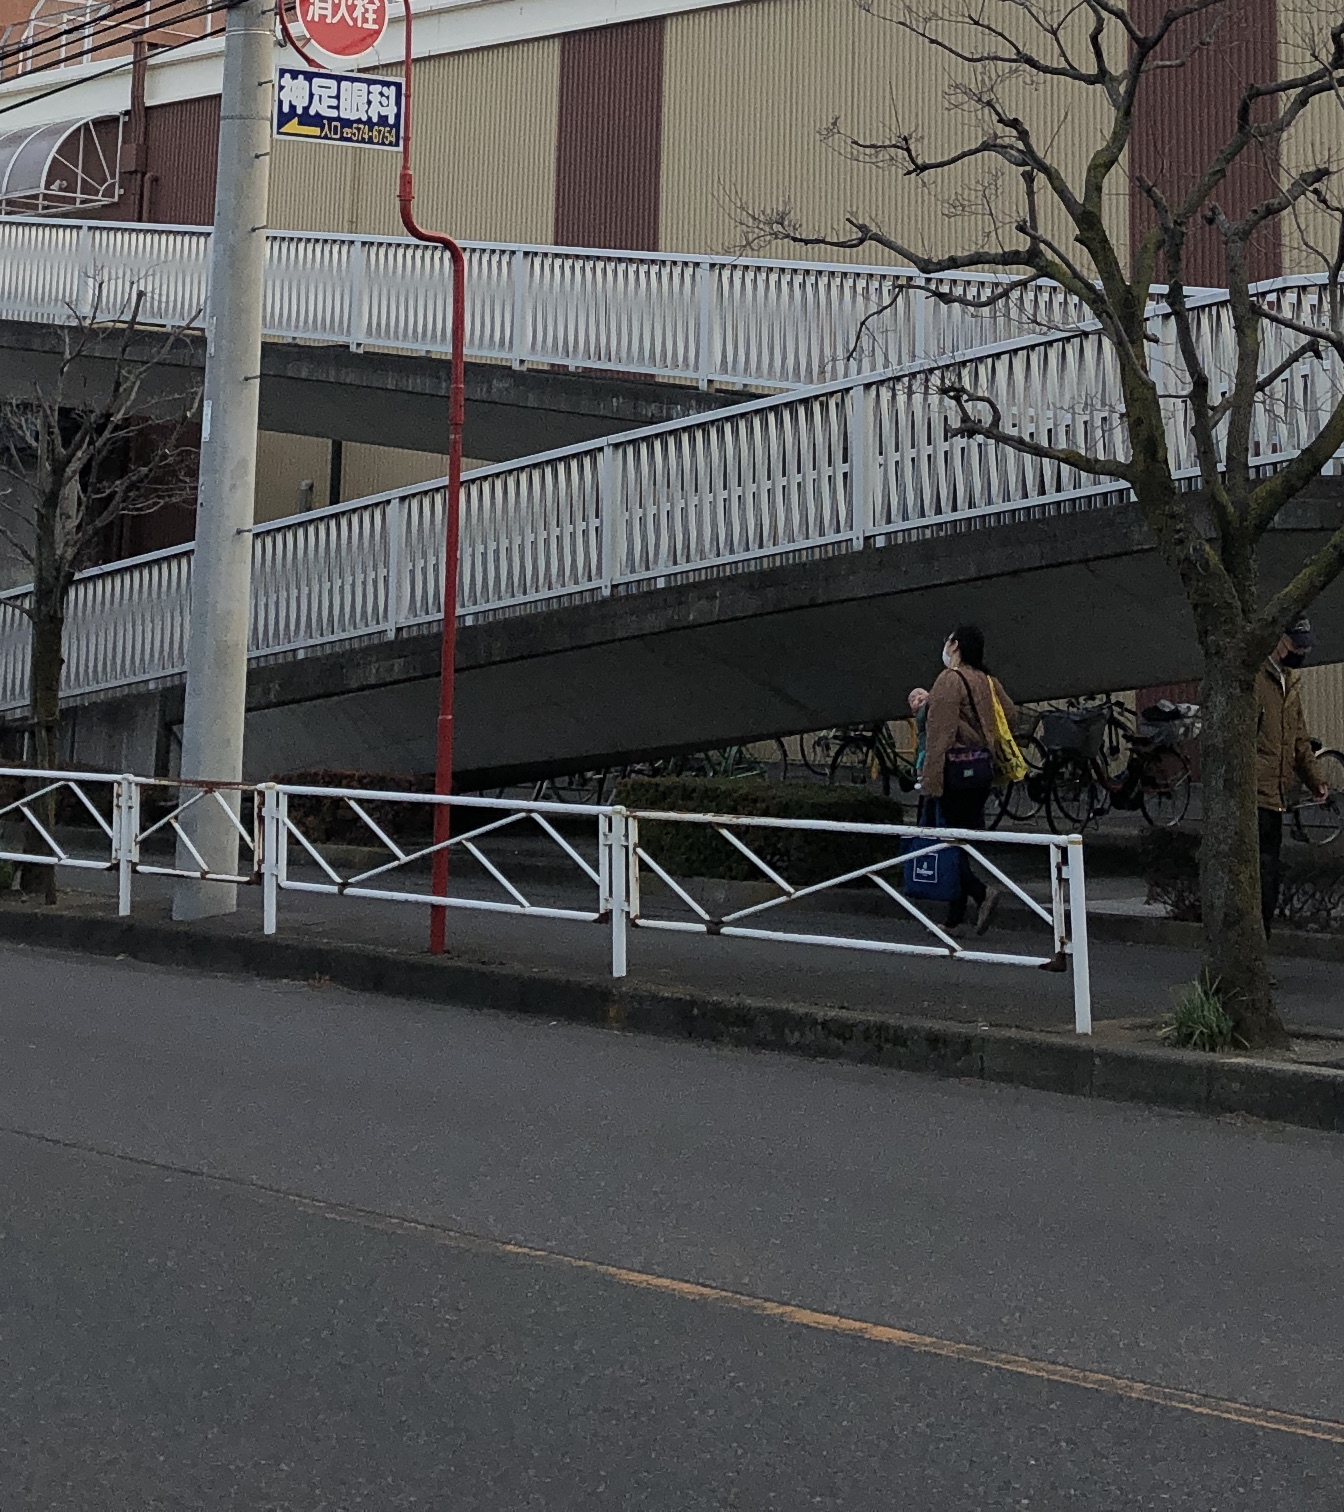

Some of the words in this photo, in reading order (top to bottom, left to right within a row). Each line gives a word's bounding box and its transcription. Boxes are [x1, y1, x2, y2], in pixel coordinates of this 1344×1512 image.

[279, 72, 397, 125] 神足眼科
[320, 119, 341, 139] 入口
[351, 123, 396, 145] 574-6754
